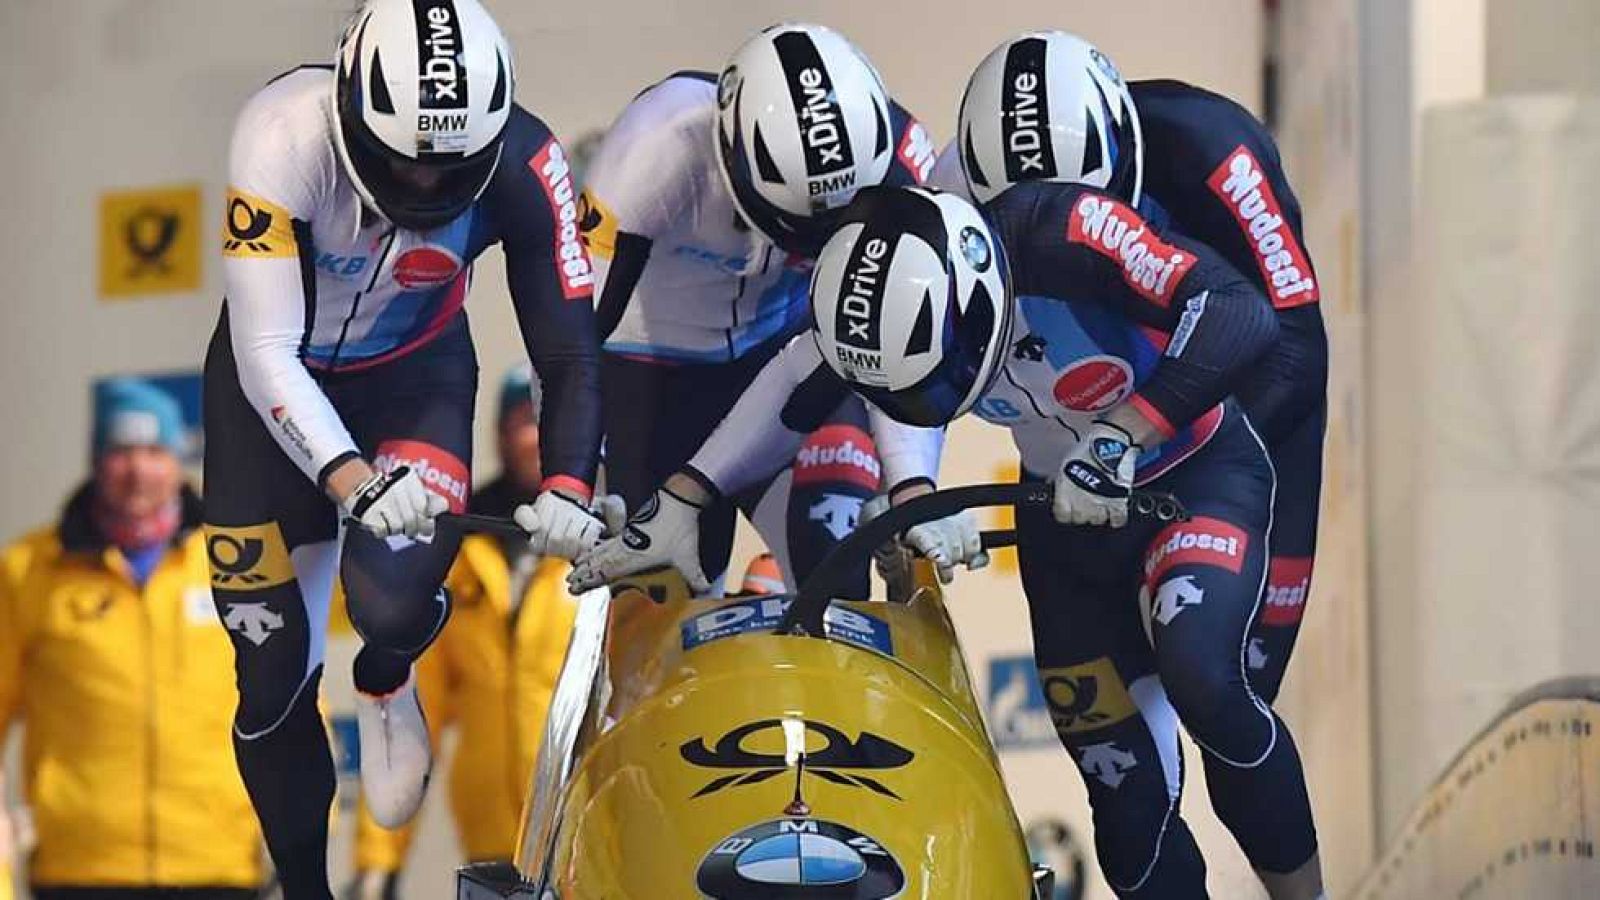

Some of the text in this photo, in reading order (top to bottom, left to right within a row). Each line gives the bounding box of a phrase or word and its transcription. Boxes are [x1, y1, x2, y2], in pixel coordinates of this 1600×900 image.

[424, 7, 457, 100] xDrive
[417, 114, 468, 131] BMW
[800, 67, 843, 166] xDrive
[1000, 72, 1044, 172] xDrive
[542, 142, 594, 288] Nudossi
[808, 172, 857, 196] BMW
[1221, 153, 1315, 299] Nudossi
[316, 252, 367, 275] KB
[843, 238, 888, 341] xDrive
[1078, 197, 1184, 296] Nudossi
[836, 345, 882, 369] BMW
[713, 820, 888, 856] BMW
